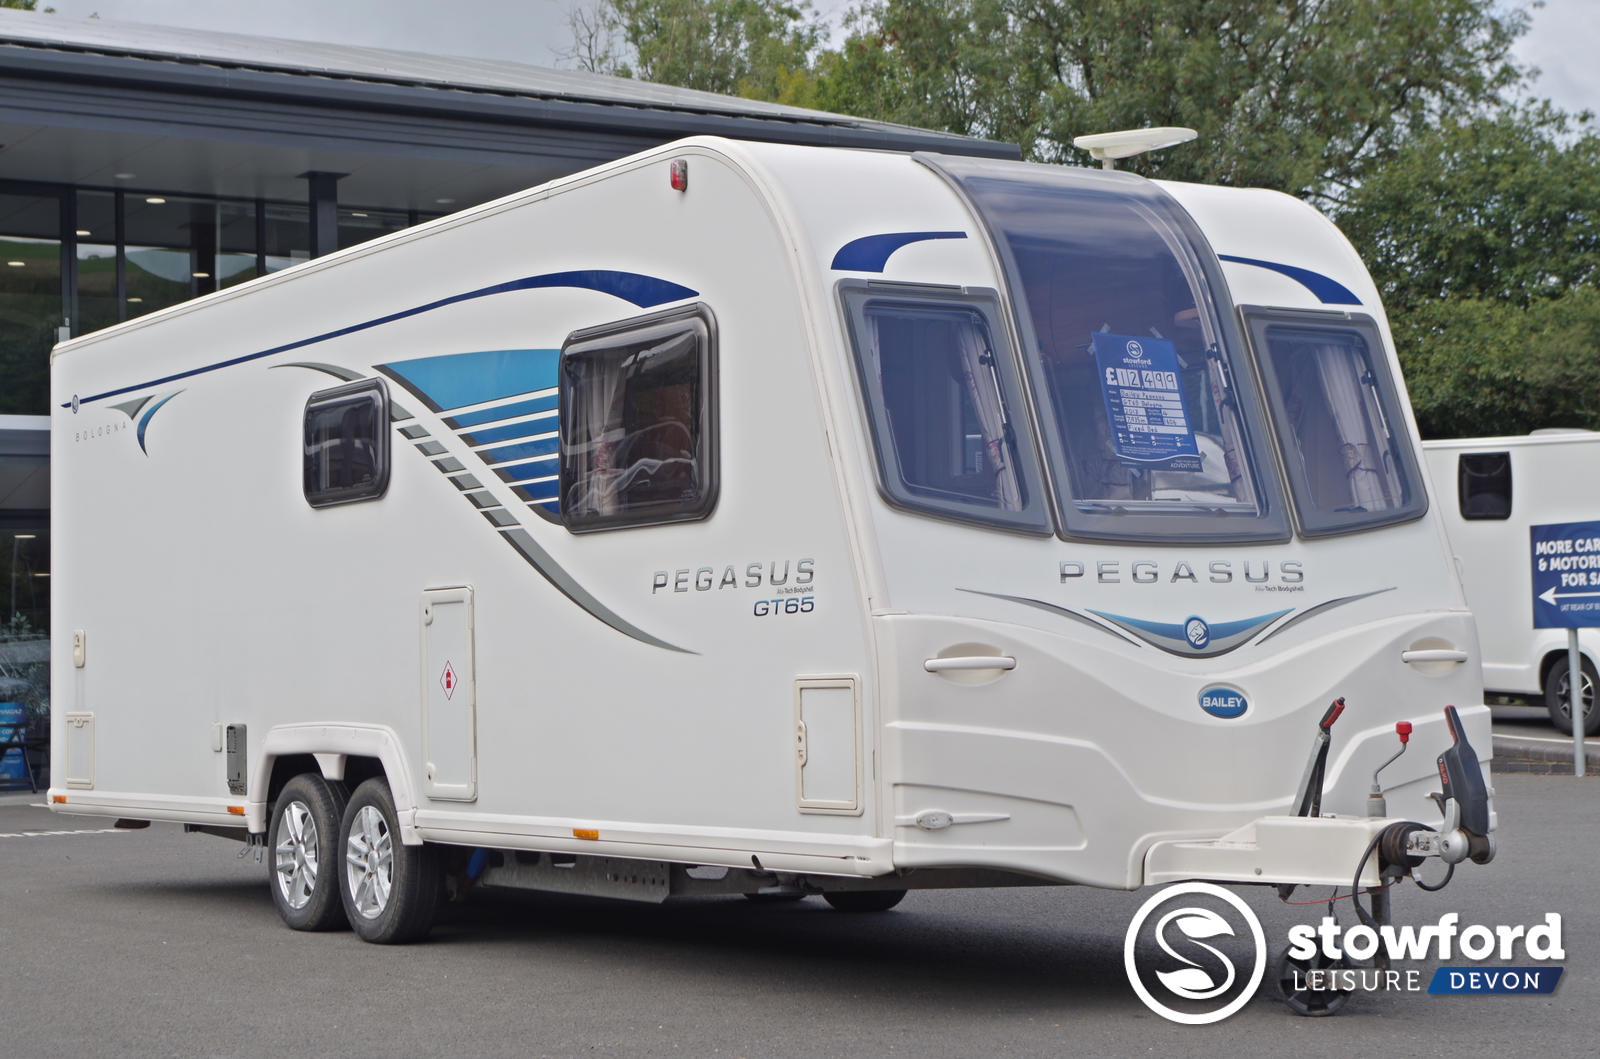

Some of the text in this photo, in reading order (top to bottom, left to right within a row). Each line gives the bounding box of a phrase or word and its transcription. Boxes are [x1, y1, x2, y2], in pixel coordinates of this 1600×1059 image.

[1106, 367, 1177, 389] £12,499
[75, 421, 126, 442] BOLOGNA
[1536, 541, 1572, 555] MORE
[1059, 560, 1304, 584] PEGASUS
[1538, 558, 1547, 572] &
[652, 558, 815, 594] PEGASUS
[1561, 573, 1587, 587] FOR
[753, 596, 815, 617] GT65
[1202, 696, 1243, 708] BAILEY
